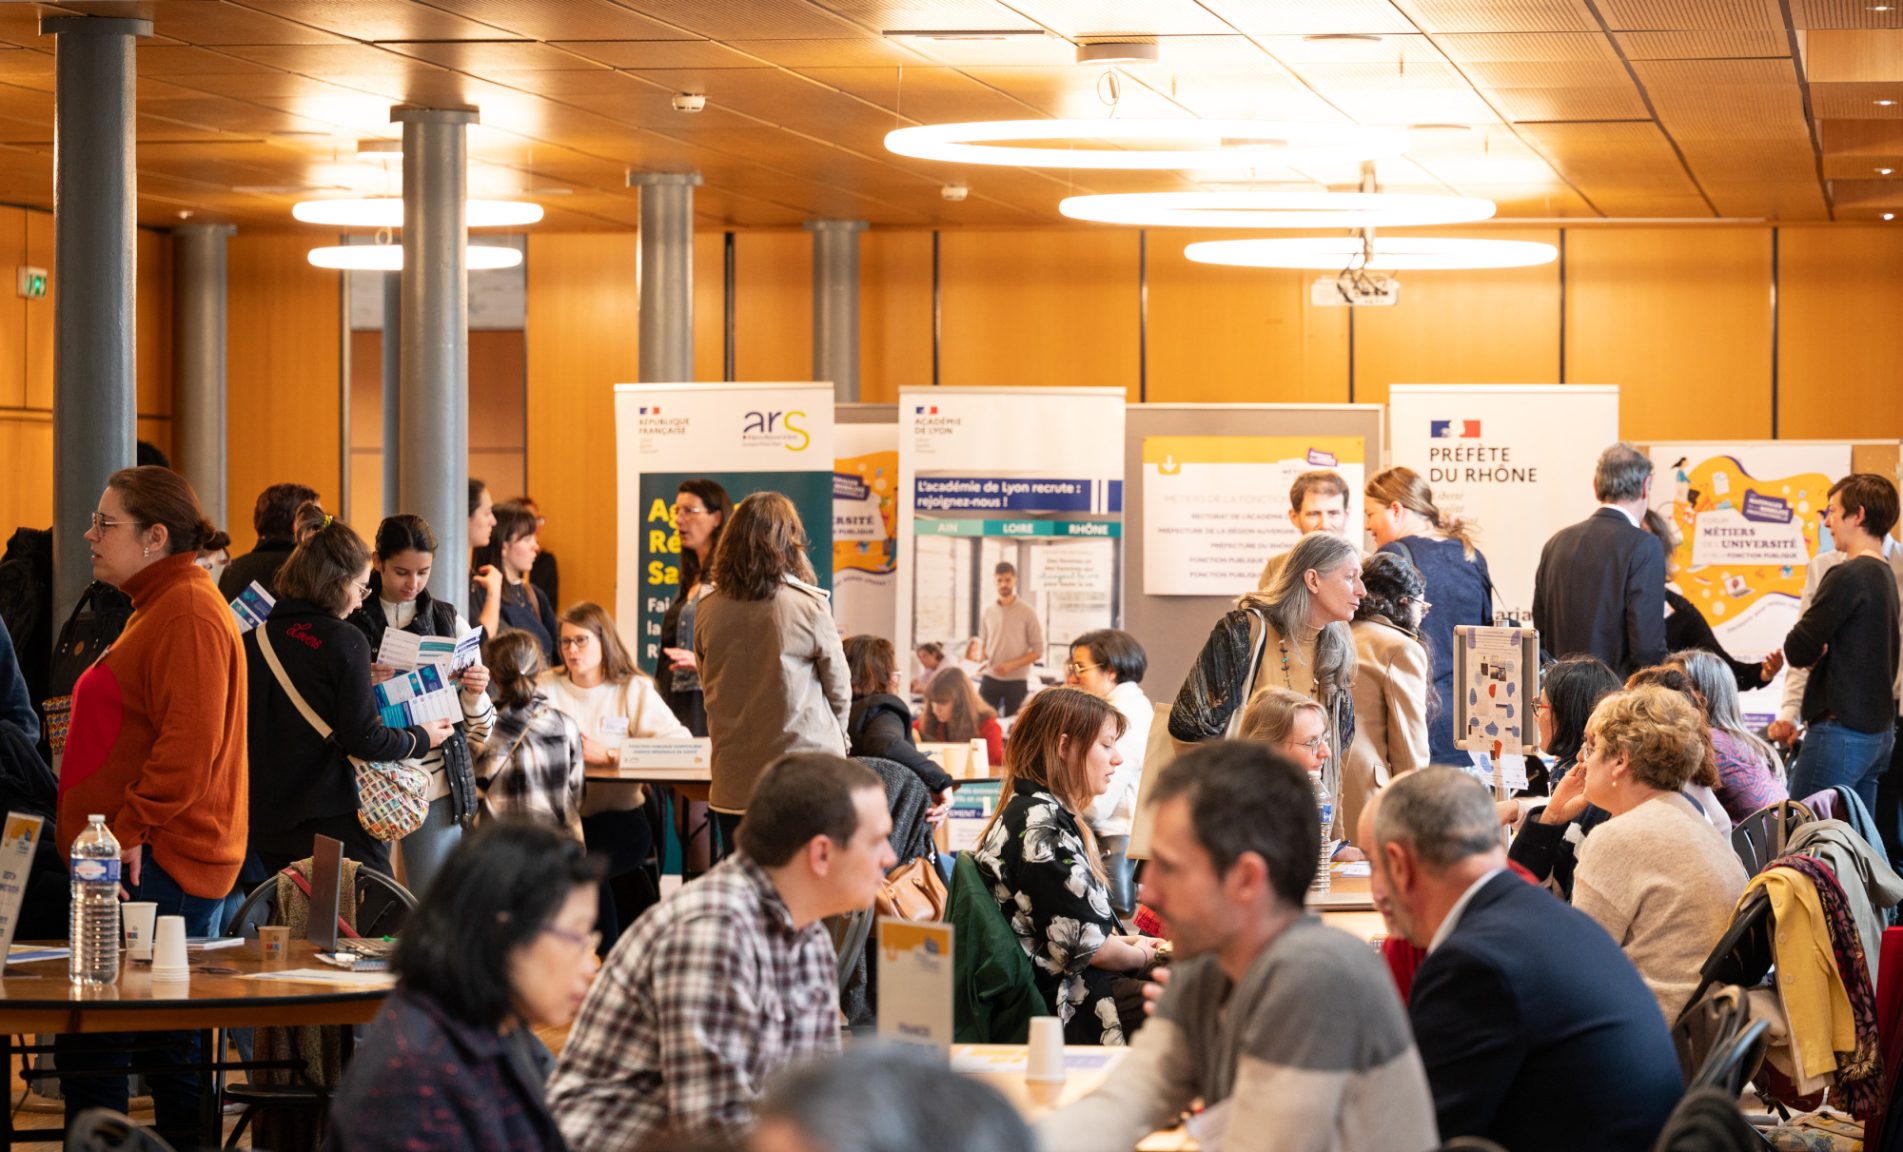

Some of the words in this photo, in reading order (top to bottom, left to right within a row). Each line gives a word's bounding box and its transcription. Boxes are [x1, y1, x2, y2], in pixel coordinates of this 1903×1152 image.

[915, 416, 961, 425] ACADÉMIE
[743, 411, 811, 451] ars
[1430, 444, 1510, 462] PRÉFÈTE
[1430, 468, 1458, 482] DU
[1465, 464, 1538, 482] RHÔNE
[917, 480, 981, 493] L'académie
[983, 481, 999, 493] de
[1002, 482, 1030, 496] Lyon
[1031, 483, 1074, 494] recrute
[917, 496, 1001, 510] rejoignez-nous
[937, 523, 958, 533] AIN
[1003, 523, 1034, 534] LOIRE
[1068, 522, 1108, 535] RHÔNE
[1703, 526, 1756, 536] MÉTIERS
[649, 529, 682, 554] Ré
[647, 560, 679, 585] Sa
[647, 596, 670, 613] Fai
[647, 620, 661, 636] la
